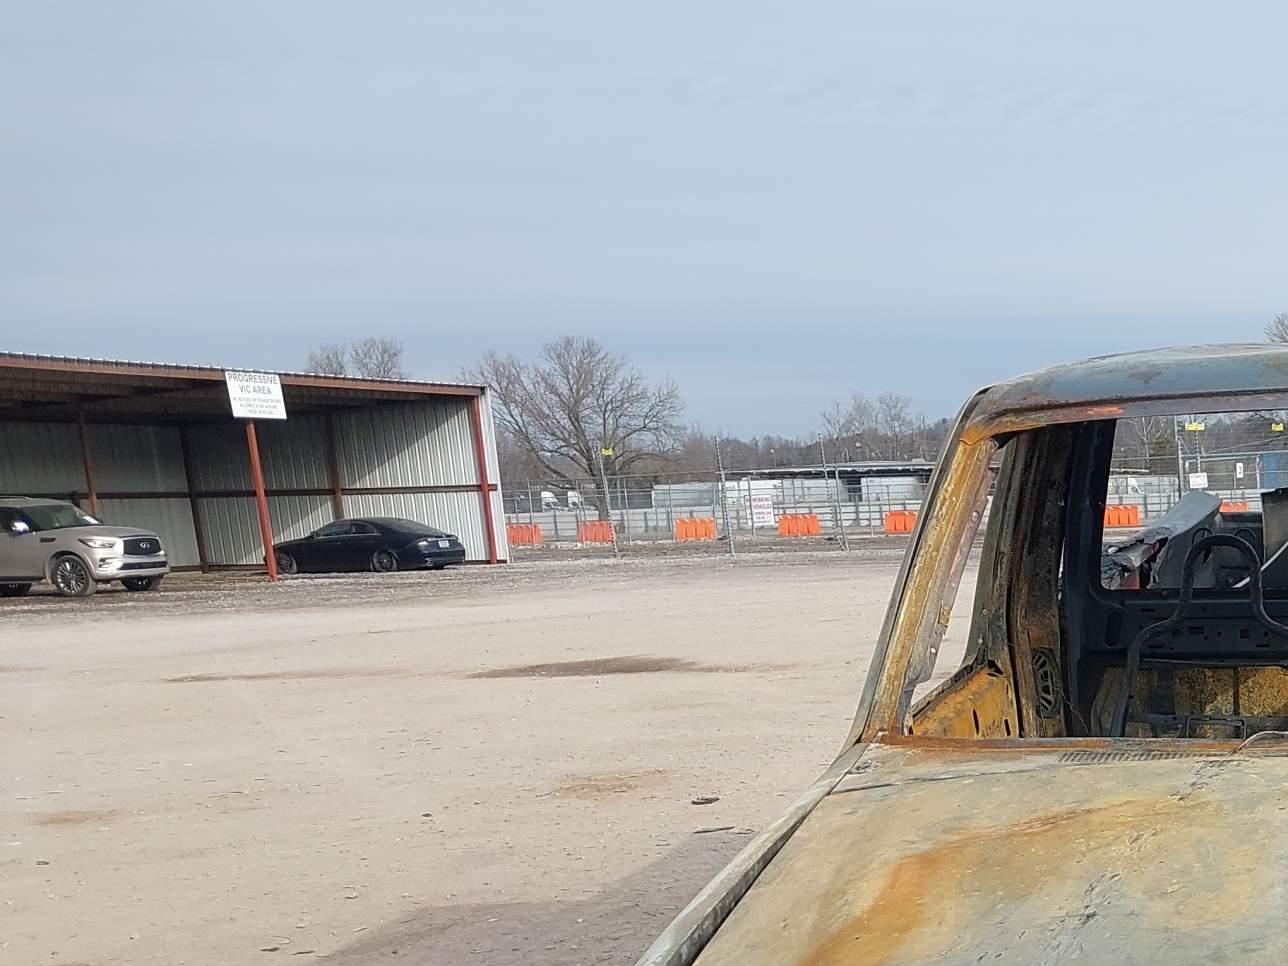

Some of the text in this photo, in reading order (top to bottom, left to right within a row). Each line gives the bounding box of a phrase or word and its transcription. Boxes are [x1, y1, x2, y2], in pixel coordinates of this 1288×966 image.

[228, 373, 278, 384] PROGRESSIVE
[239, 385, 272, 395] VIC AREA
